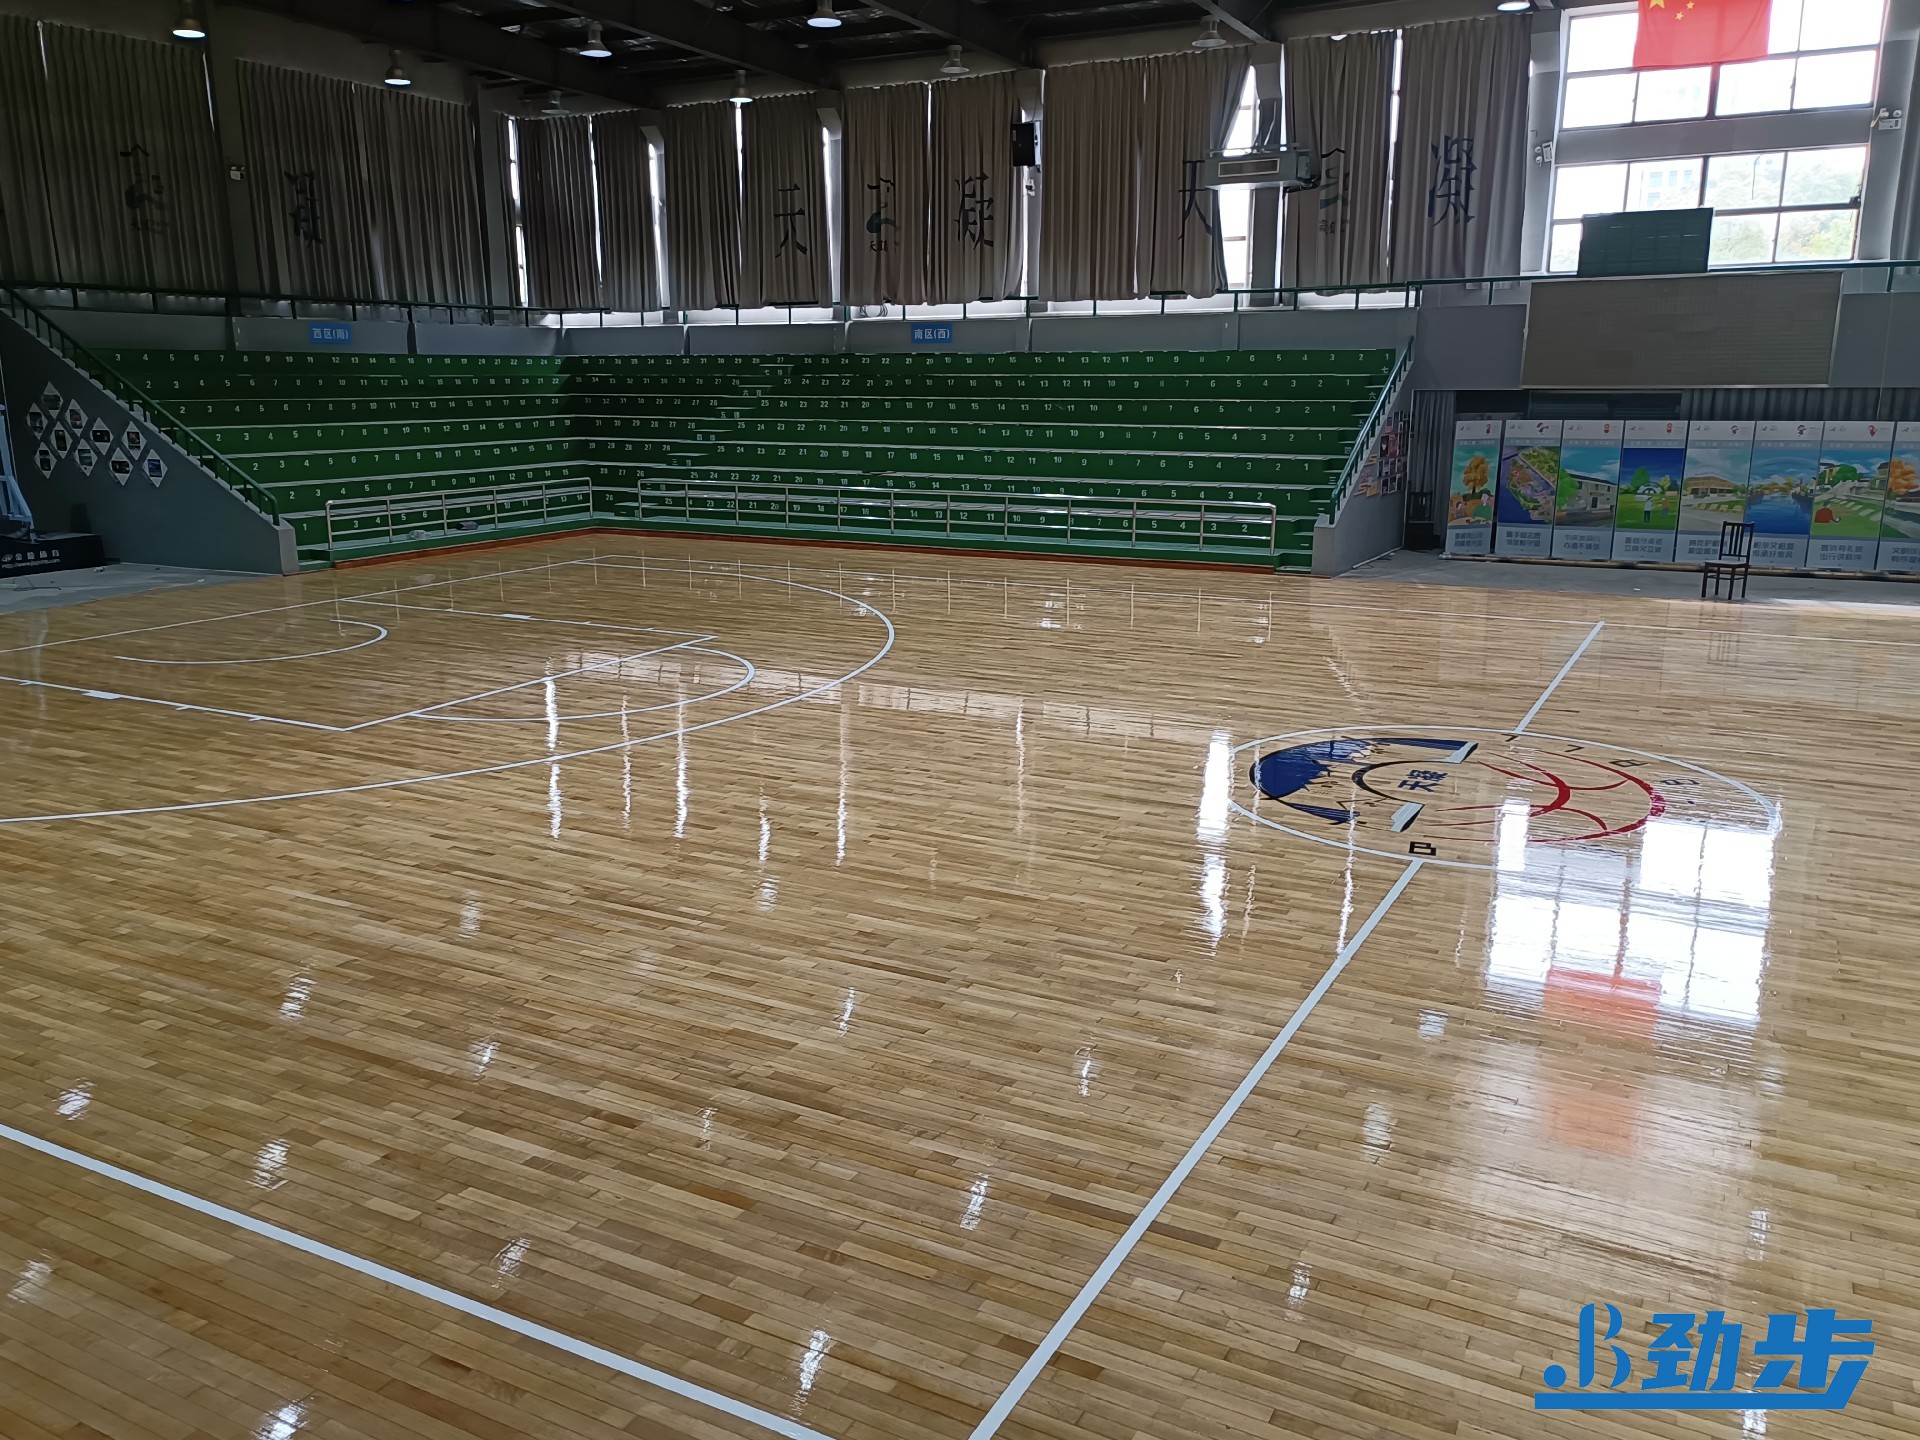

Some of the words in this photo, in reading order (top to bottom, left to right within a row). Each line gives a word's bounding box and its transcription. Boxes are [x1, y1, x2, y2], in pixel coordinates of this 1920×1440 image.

[312, 328, 349, 340] 西区(南)
[914, 328, 950, 340] 南区(西)
[244, 432, 249, 440] 3
[253, 462, 258, 470] 2
[1188, 460, 1194, 468] 5
[290, 491, 295, 499] 2
[1171, 490, 1176, 498] 5
[353, 520, 358, 528] 3
[1152, 520, 1157, 528] 5
[1242, 524, 1248, 532] 2
